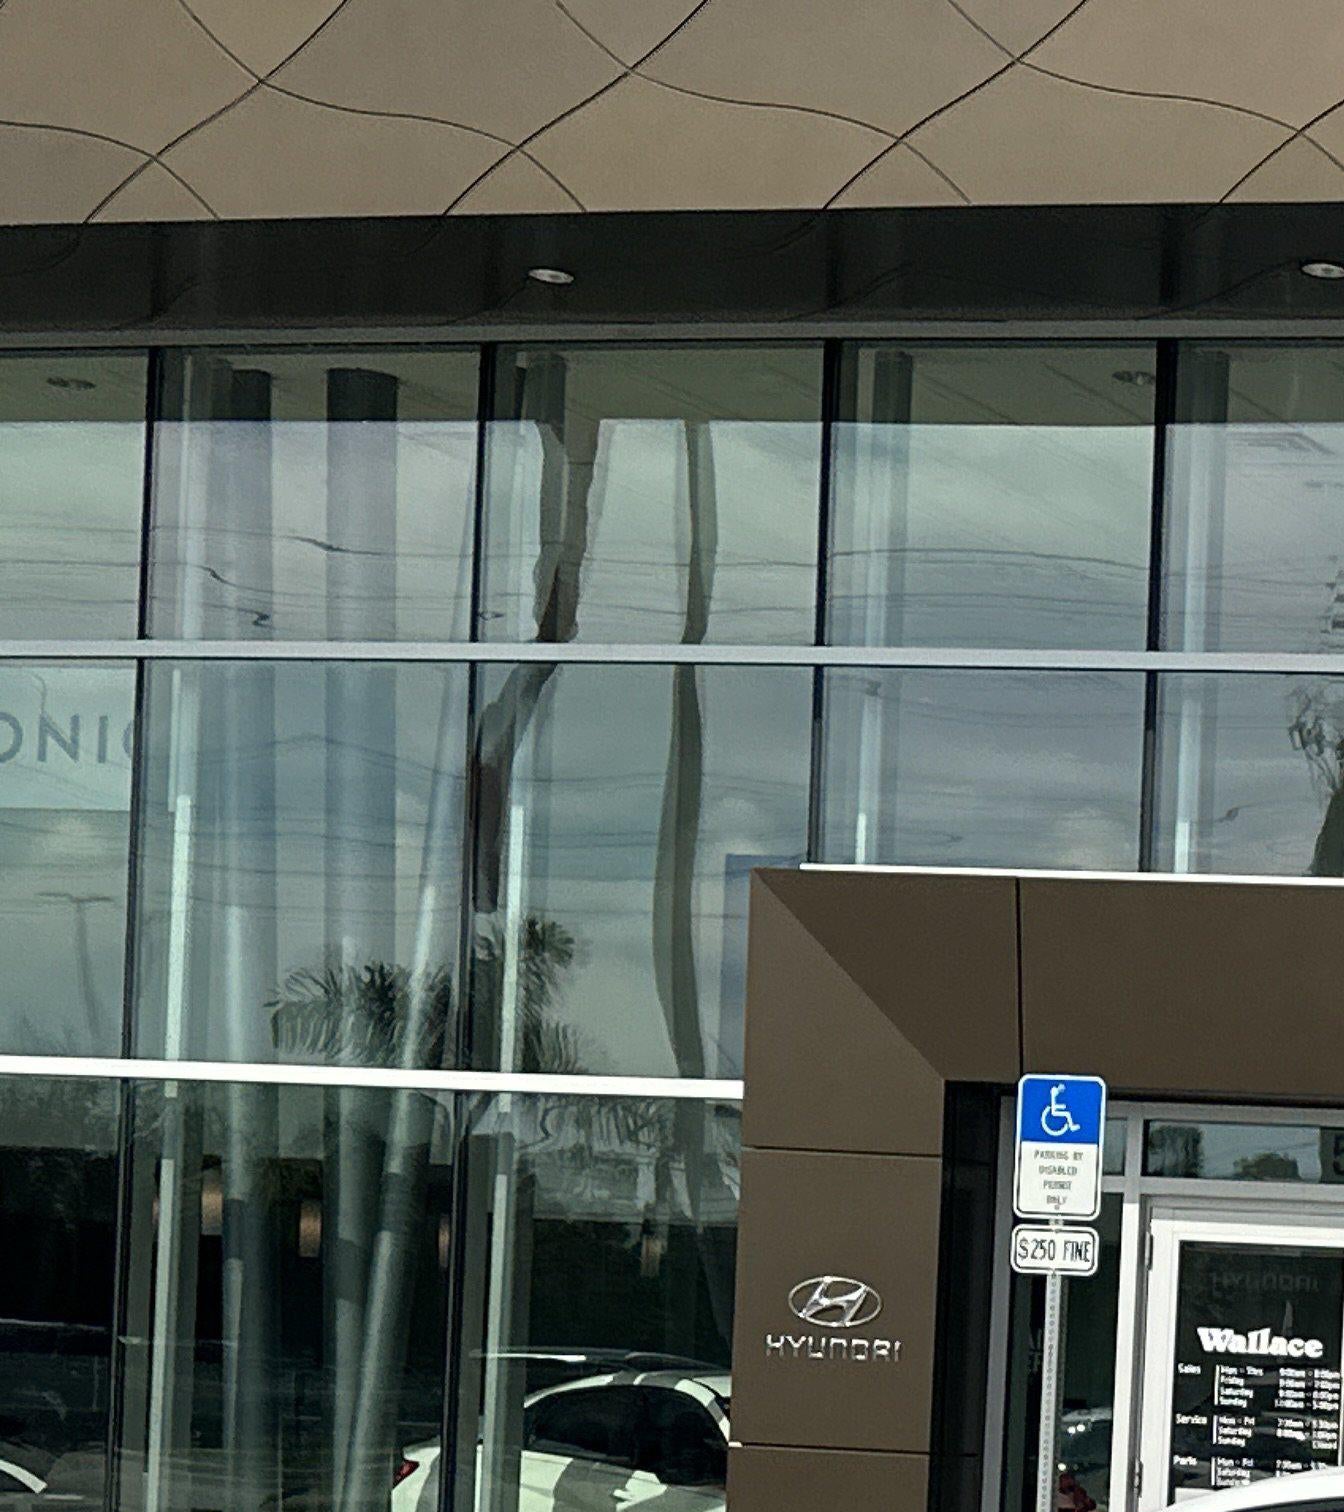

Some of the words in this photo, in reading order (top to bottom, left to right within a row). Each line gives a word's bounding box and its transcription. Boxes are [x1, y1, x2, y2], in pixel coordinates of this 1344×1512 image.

[1018, 1237, 1056, 1262] $250
[1063, 1239, 1092, 1262] FINE
[765, 1334, 901, 1362] HYUNDAI
[1197, 1327, 1324, 1358] Wallace
